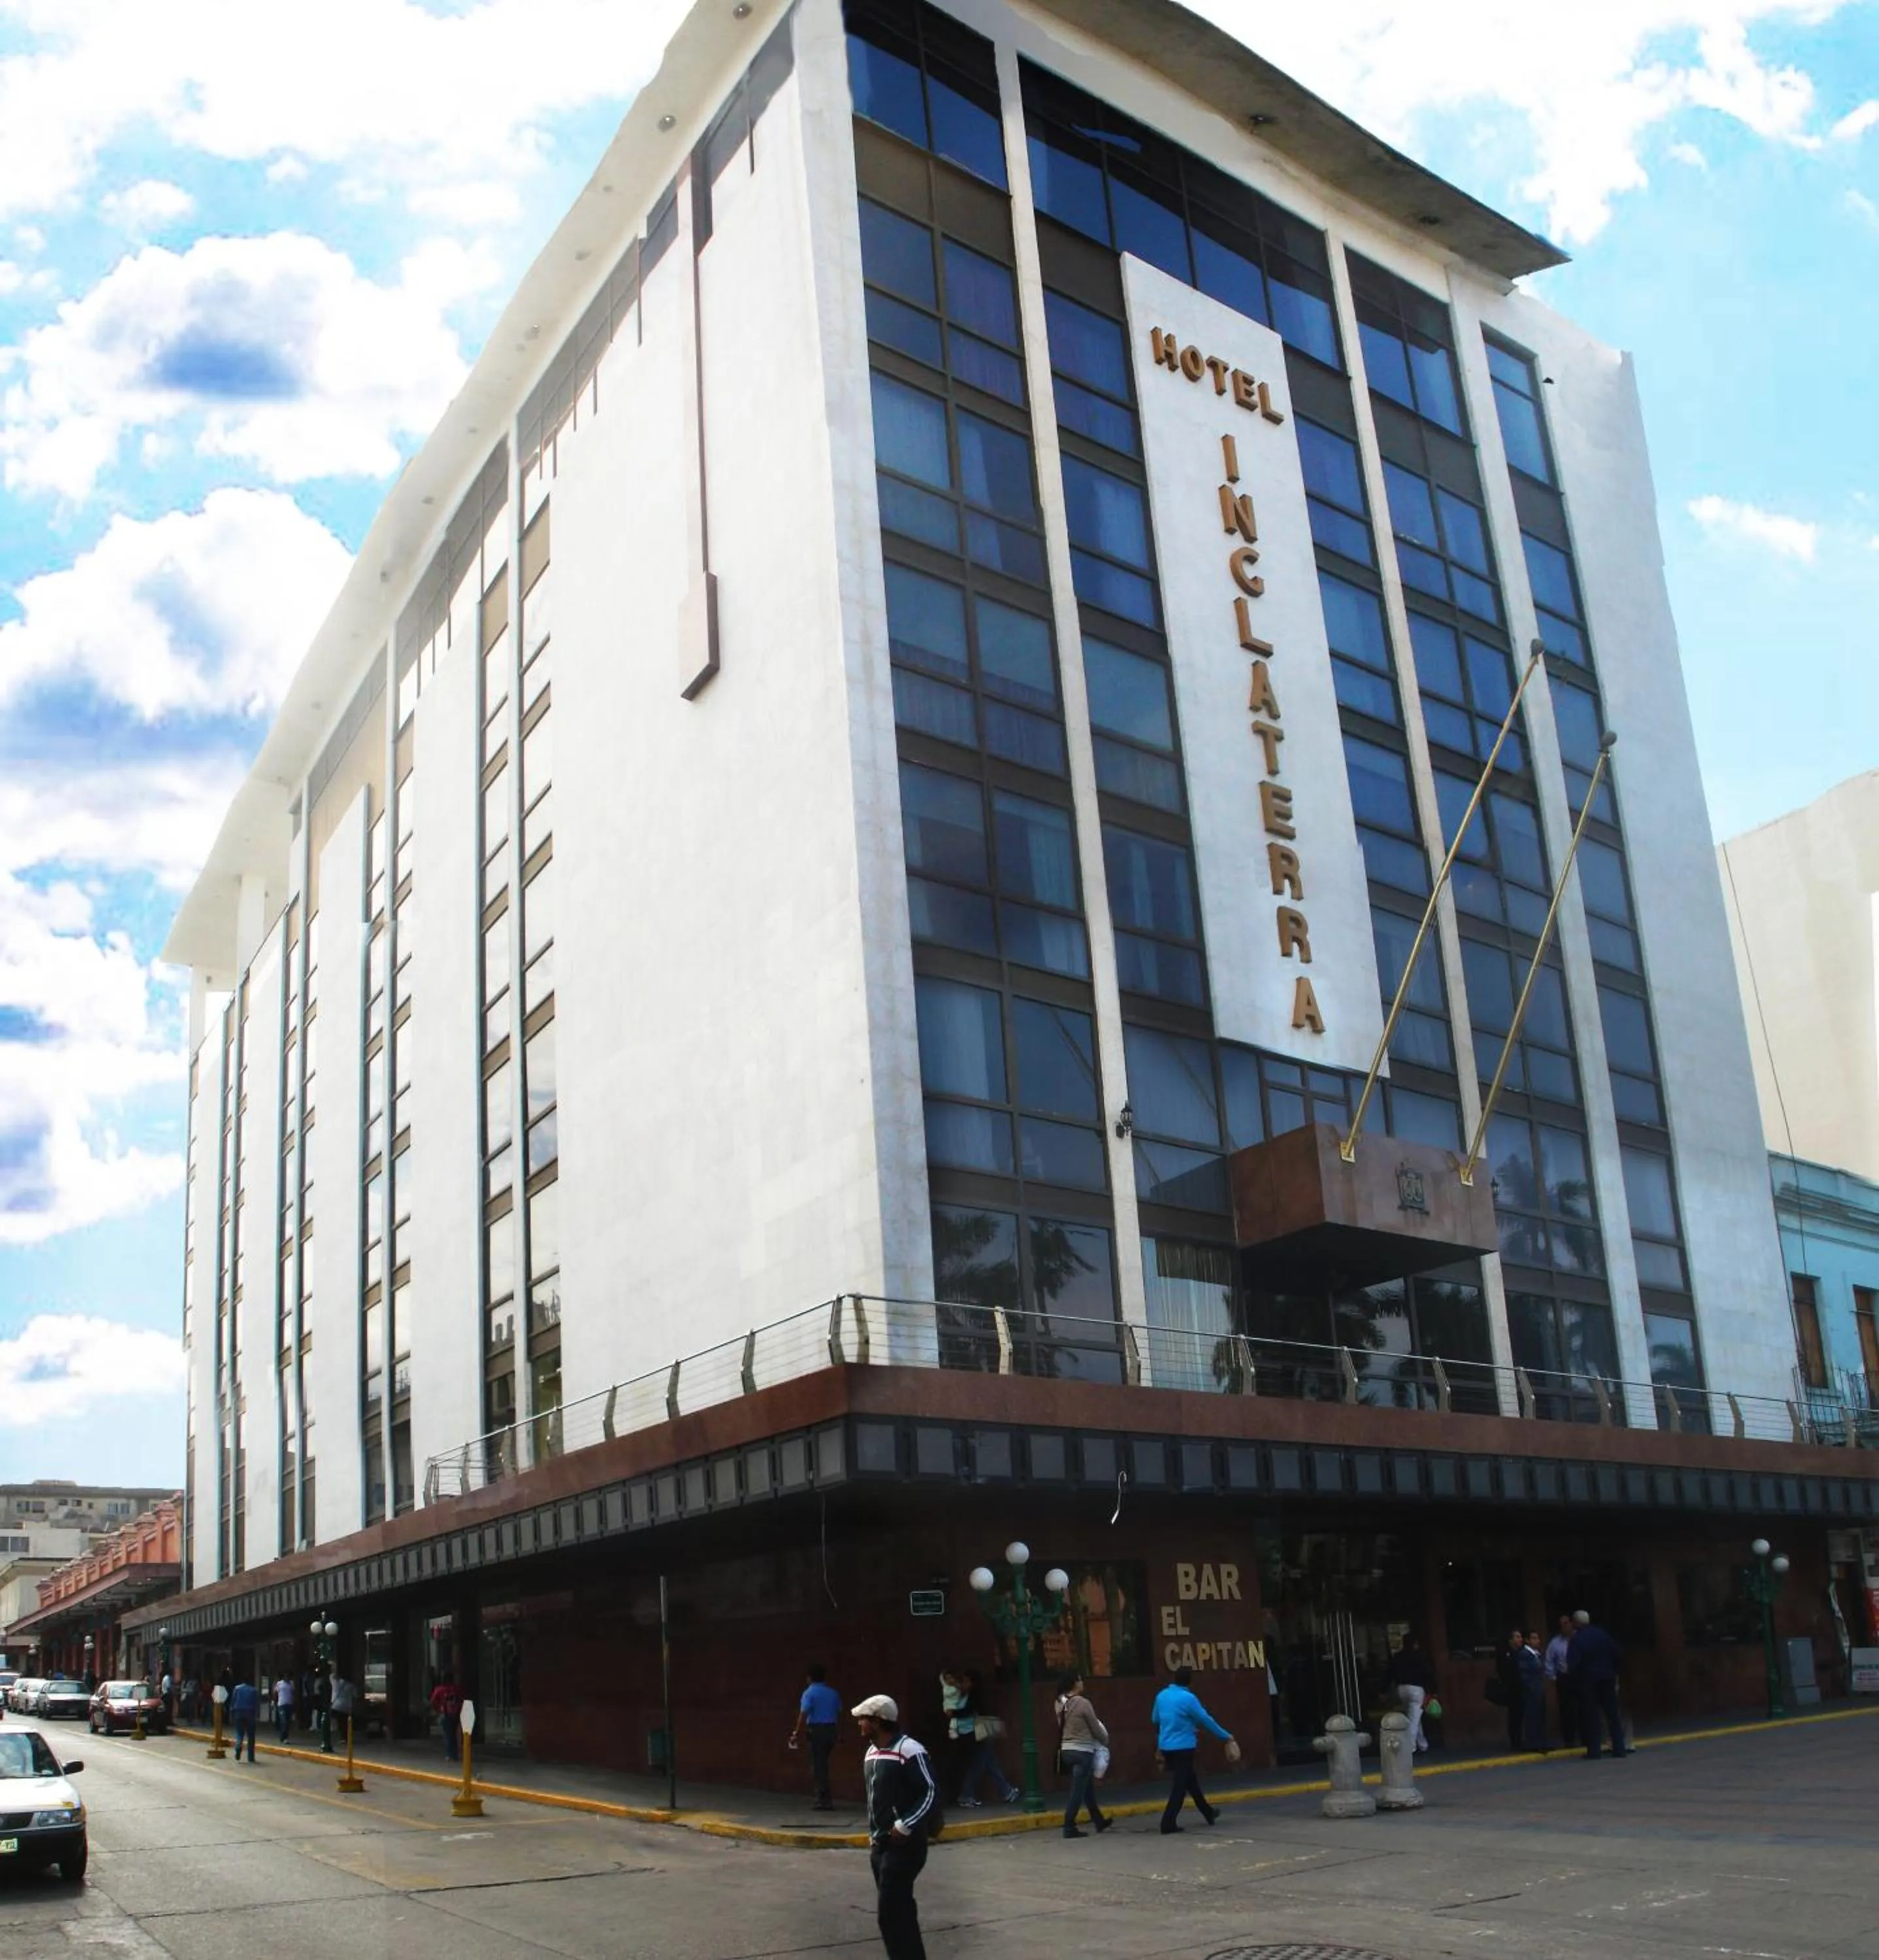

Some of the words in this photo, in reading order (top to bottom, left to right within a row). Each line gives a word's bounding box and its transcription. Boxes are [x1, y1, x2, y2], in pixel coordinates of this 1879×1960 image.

[1151, 326, 1284, 425] HOTEL
[1177, 1563, 1242, 1600] BAR
[1161, 1605, 1190, 1636] EL
[1164, 1641, 1265, 1671] CAPITAN
